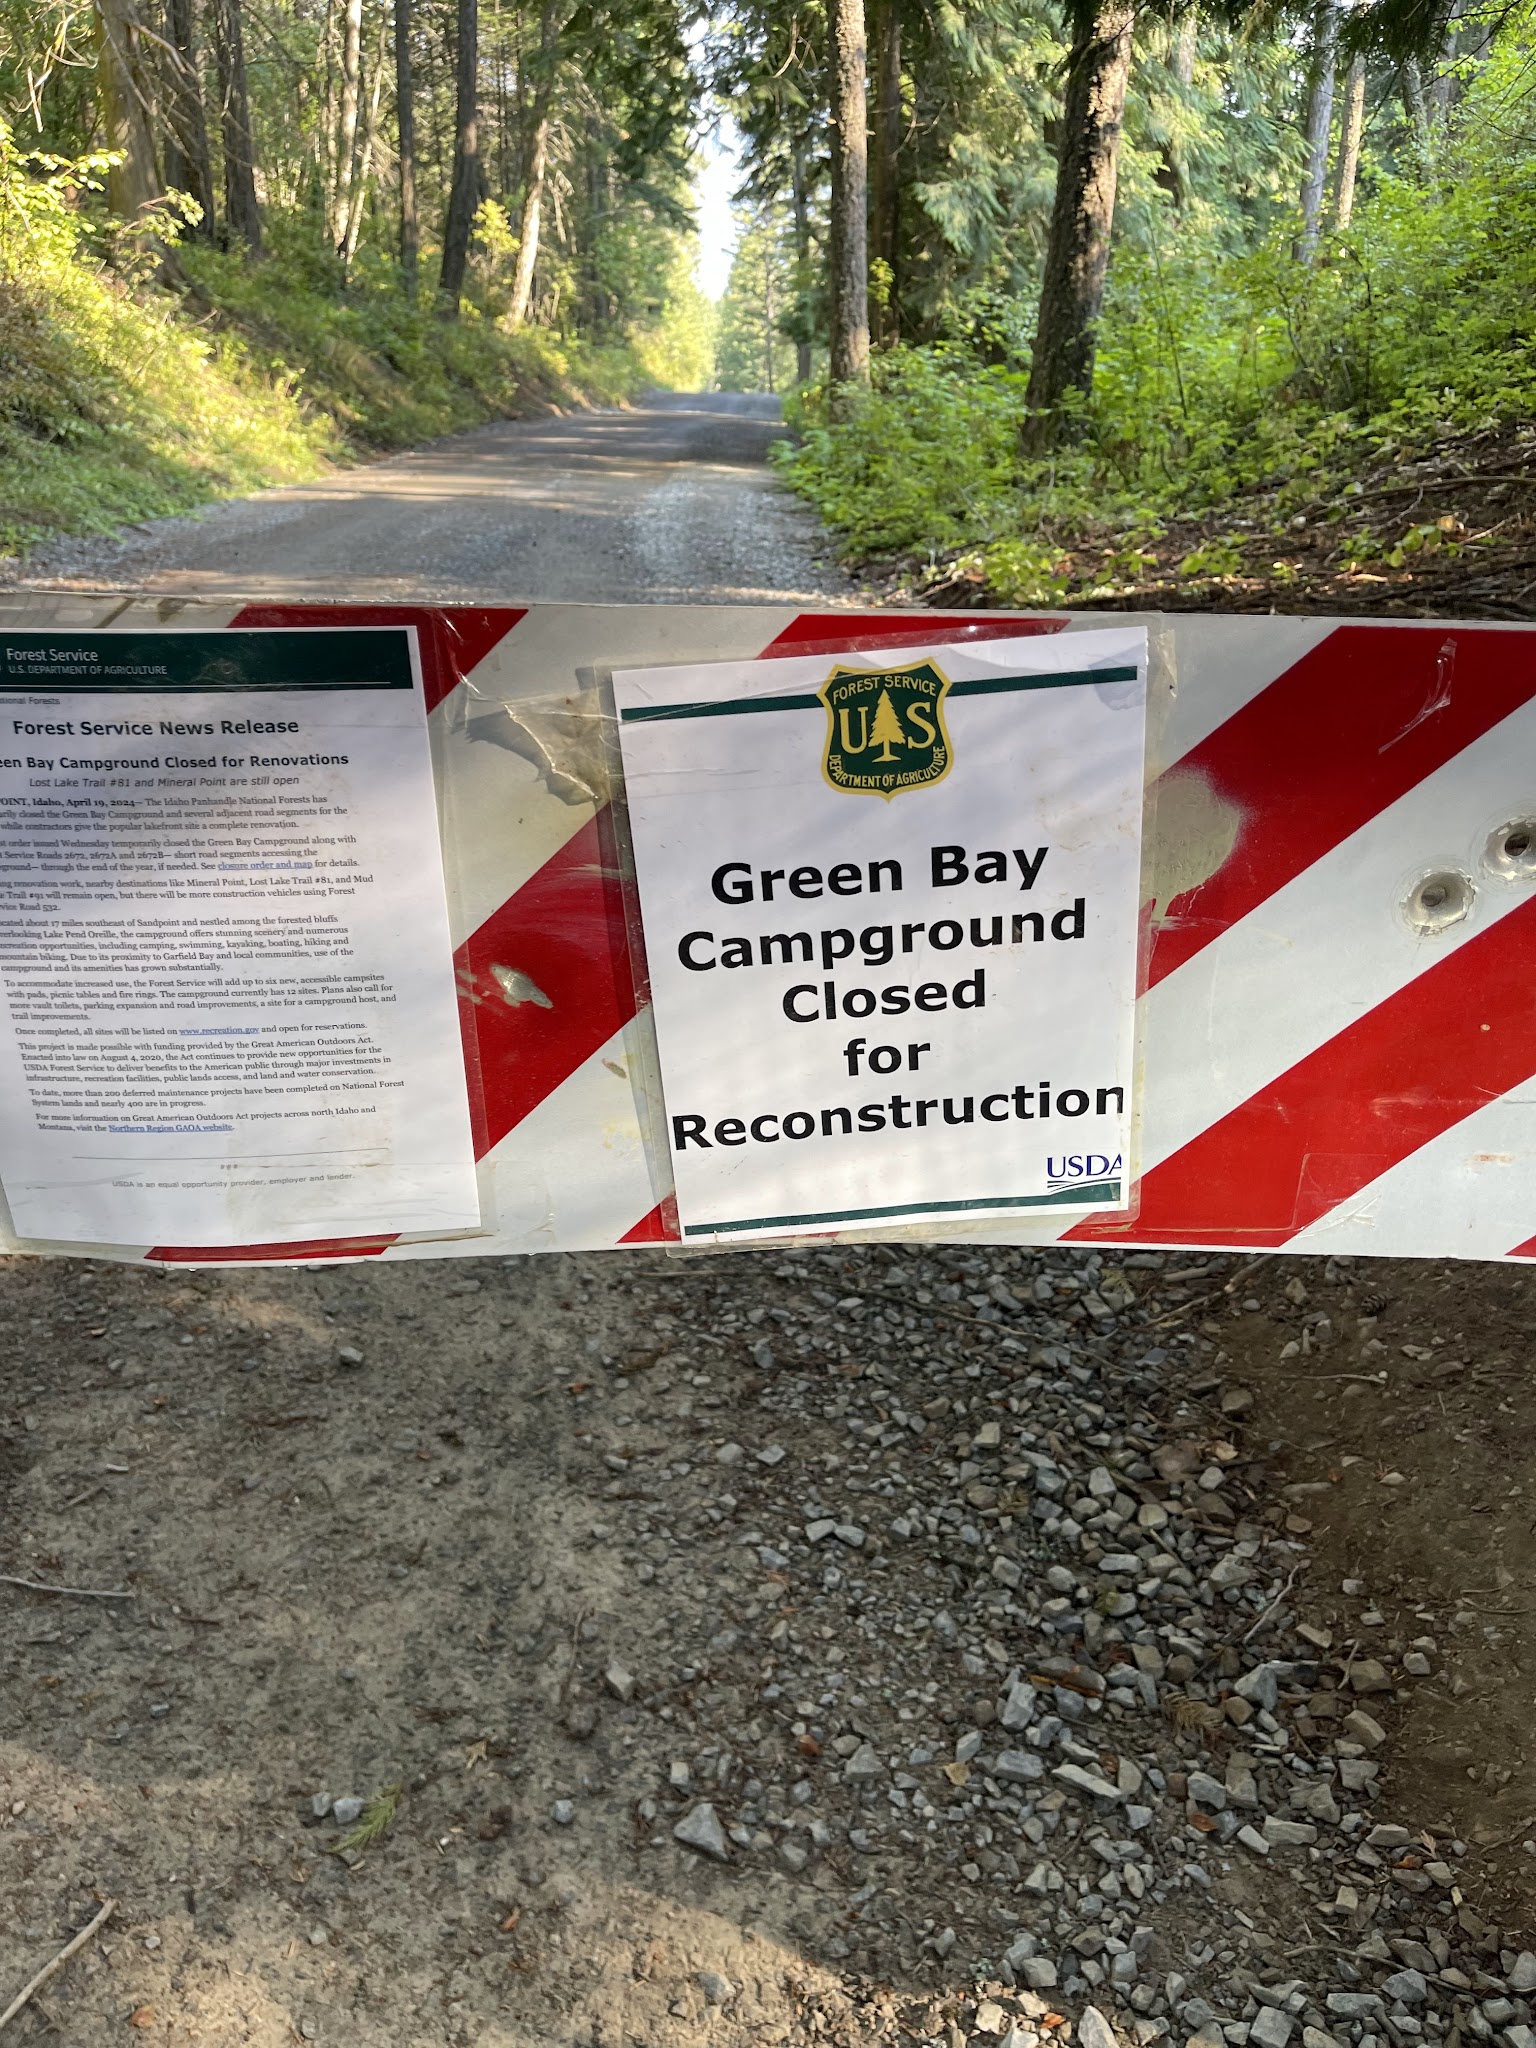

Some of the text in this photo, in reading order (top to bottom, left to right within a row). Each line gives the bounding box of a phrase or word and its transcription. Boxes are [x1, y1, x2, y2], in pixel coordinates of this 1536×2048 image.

[6, 648, 98, 662] Forest Service
[9, 665, 168, 675] U.S. DEPARTMENT OF AGRICULTURE
[832, 675, 937, 705] FOREST SERVICE
[29, 697, 61, 705] Forests
[13, 719, 299, 735] Forest Service News Release
[838, 702, 936, 754] U S
[0, 754, 349, 771] een Bay Campground Closed for Renovations
[829, 745, 945, 787] DEPARTMENT OF AGRICULTURE
[29, 778, 51, 787] Lost
[54, 778, 79, 787] Lake
[82, 778, 105, 787] Trail
[110, 778, 130, 787] #81
[134, 778, 154, 787] and
[158, 778, 196, 787] Mineral
[199, 778, 226, 787] Point
[251, 777, 270, 786] still
[273, 779, 299, 788] open
[66, 799, 91, 808] April
[145, 798, 162, 806] The
[164, 798, 190, 806] Idaho
[238, 797, 276, 805] National
[278, 796, 310, 804] Forests
[14, 880, 58, 888] renovation
[85, 880, 114, 890] nearby
[186, 879, 220, 887] Mineral
[249, 878, 268, 886] Lost
[291, 877, 313, 885] Trail
[335, 876, 352, 884] and
[353, 875, 374, 883] Mud
[711, 845, 1049, 905] Green Bay
[120, 930, 134, 938] the
[135, 930, 188, 940] campground
[215, 929, 252, 939] stunning
[254, 930, 286, 938] scenery
[286, 927, 304, 935] and
[678, 897, 1086, 971] Campground
[1, 964, 52, 973] campground
[50, 991, 74, 1000] picnic
[177, 990, 229, 1000] campground
[231, 988, 268, 999] currently
[321, 986, 344, 994] Plans
[346, 985, 363, 993] also
[380, 984, 393, 992] for
[782, 968, 986, 1023] Closed
[179, 1027, 259, 1037] www.recreation.gov
[261, 1025, 277, 1033] and
[278, 1026, 299, 1034] open
[101, 1054, 128, 1063] August
[165, 1053, 178, 1061] the
[195, 1052, 235, 1060] continues
[246, 1050, 278, 1061] provide
[298, 1048, 353, 1059] opportunities
[368, 1046, 382, 1054] the
[843, 1037, 931, 1077] for
[122, 1089, 156, 1097] deferred
[210, 1088, 242, 1098] projects
[243, 1087, 263, 1095] have
[264, 1086, 284, 1094] been
[286, 1084, 328, 1095] completed
[342, 1081, 377, 1090] National
[379, 1080, 404, 1088] Forest
[72, 1114, 119, 1122] information
[132, 1114, 154, 1122] Great
[196, 1112, 234, 1121] Outdoors
[236, 1112, 248, 1120] Act
[250, 1111, 282, 1121] projects
[284, 1110, 309, 1118] across
[311, 1108, 334, 1116] north
[335, 1107, 359, 1115] Idaho
[361, 1106, 376, 1114] and
[672, 1082, 1124, 1151] Reconstruction
[1047, 1153, 1122, 1178] USDA
